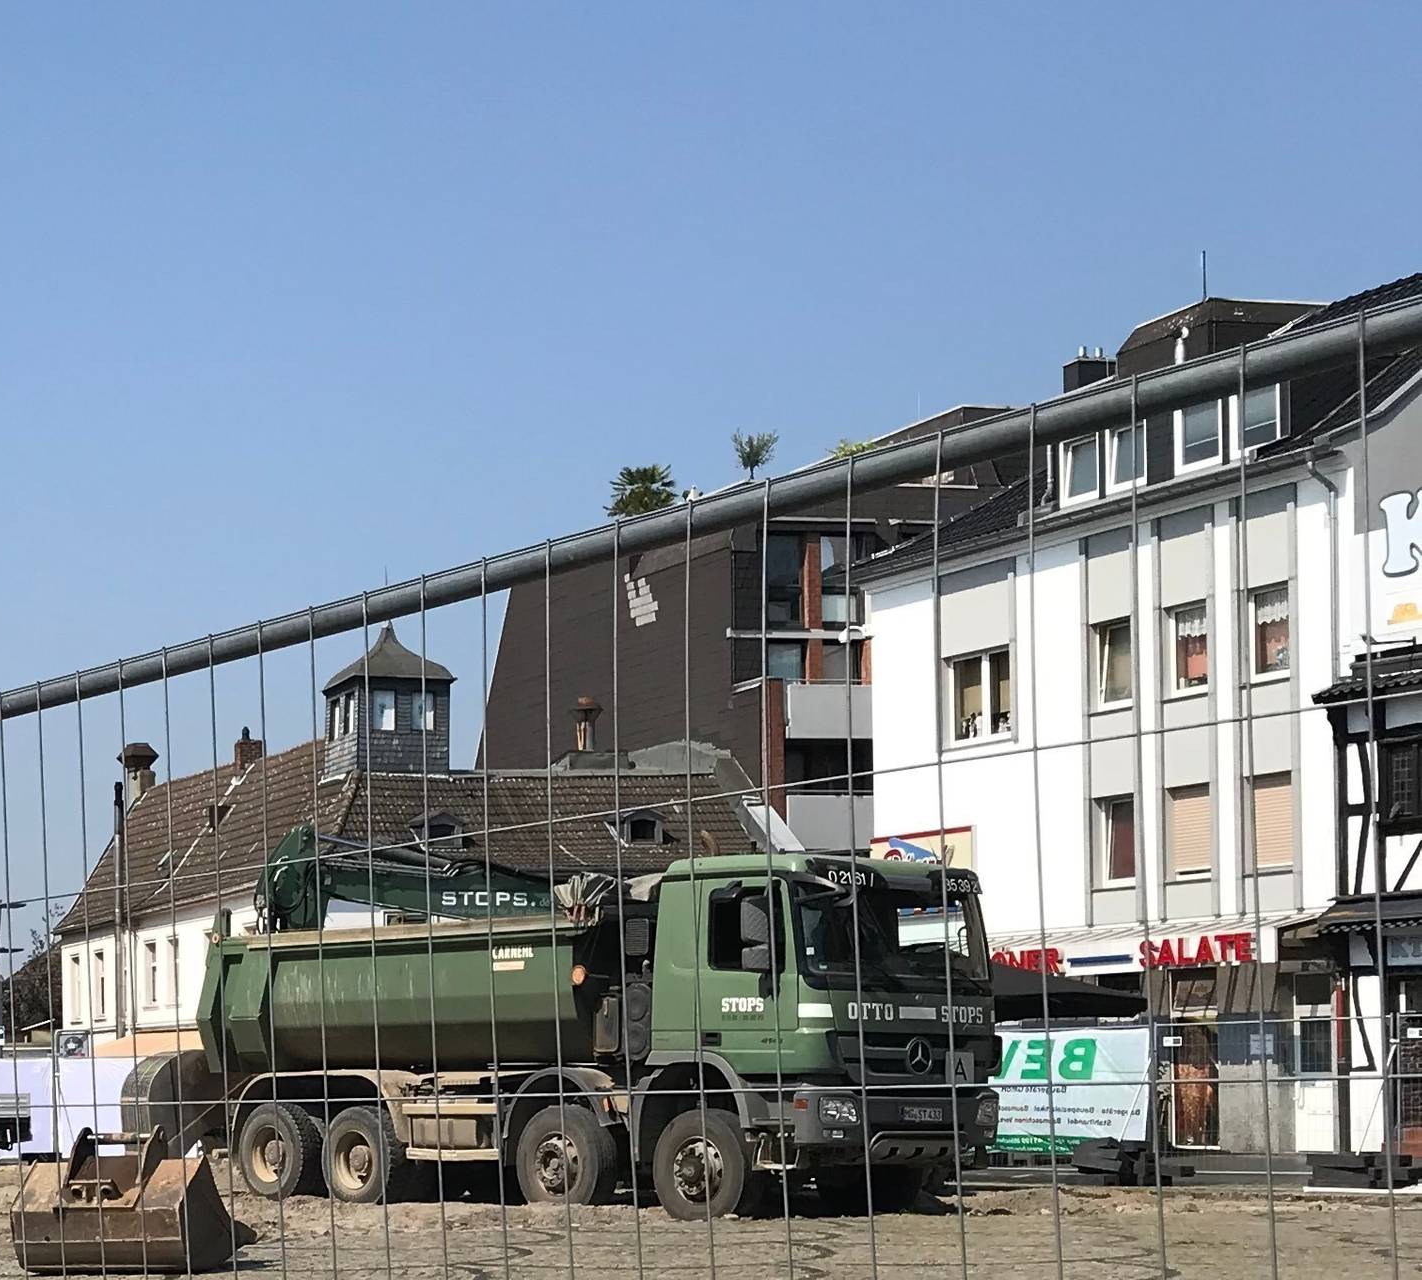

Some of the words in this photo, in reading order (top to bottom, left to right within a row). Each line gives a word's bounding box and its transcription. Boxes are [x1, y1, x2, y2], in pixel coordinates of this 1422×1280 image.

[1139, 932, 1255, 968] SALATE
[721, 997, 764, 1012] STOPS
[847, 1001, 894, 1021] OTTO
[941, 1005, 983, 1024] STOPS
[954, 1058, 968, 1081] A
